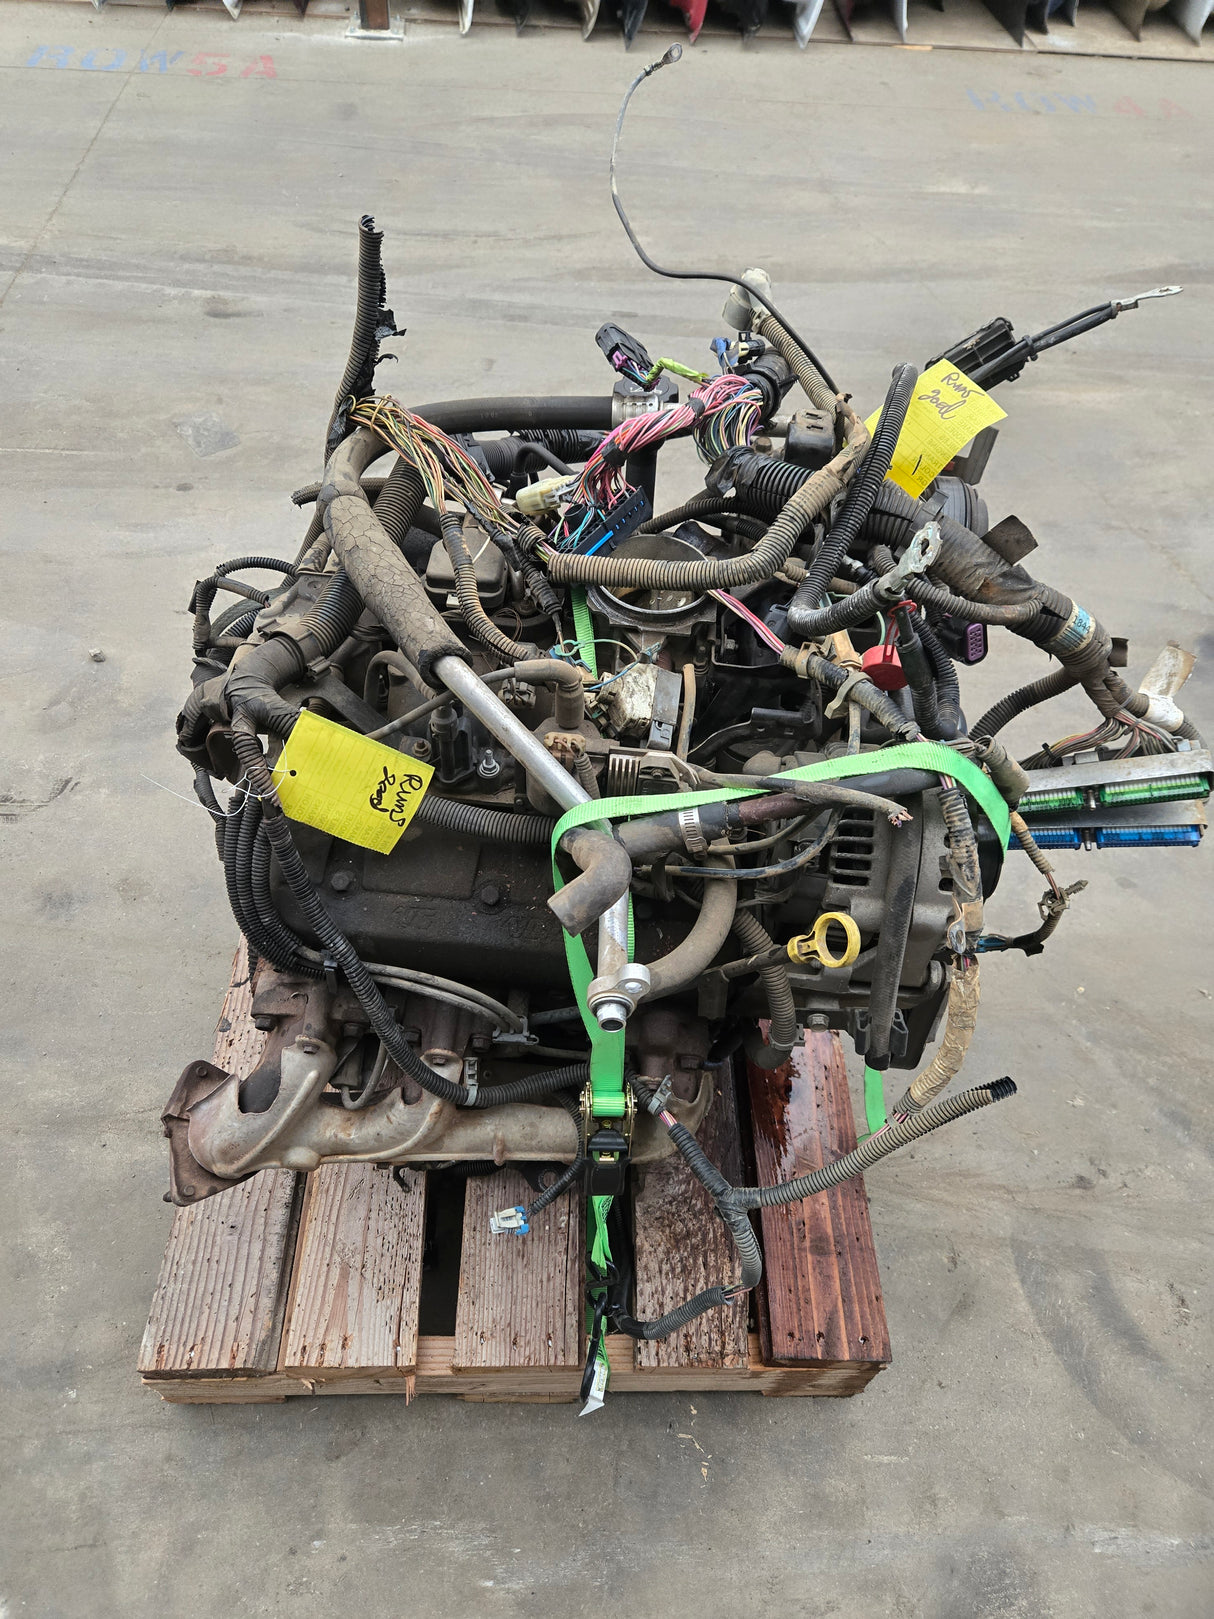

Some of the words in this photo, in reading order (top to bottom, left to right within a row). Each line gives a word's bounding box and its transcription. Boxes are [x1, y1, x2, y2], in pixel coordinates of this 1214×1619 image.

[26, 45, 184, 74] ROW
[186, 52, 278, 78] 5A
[940, 372, 985, 399] Runs
[389, 773, 423, 828] Runs
